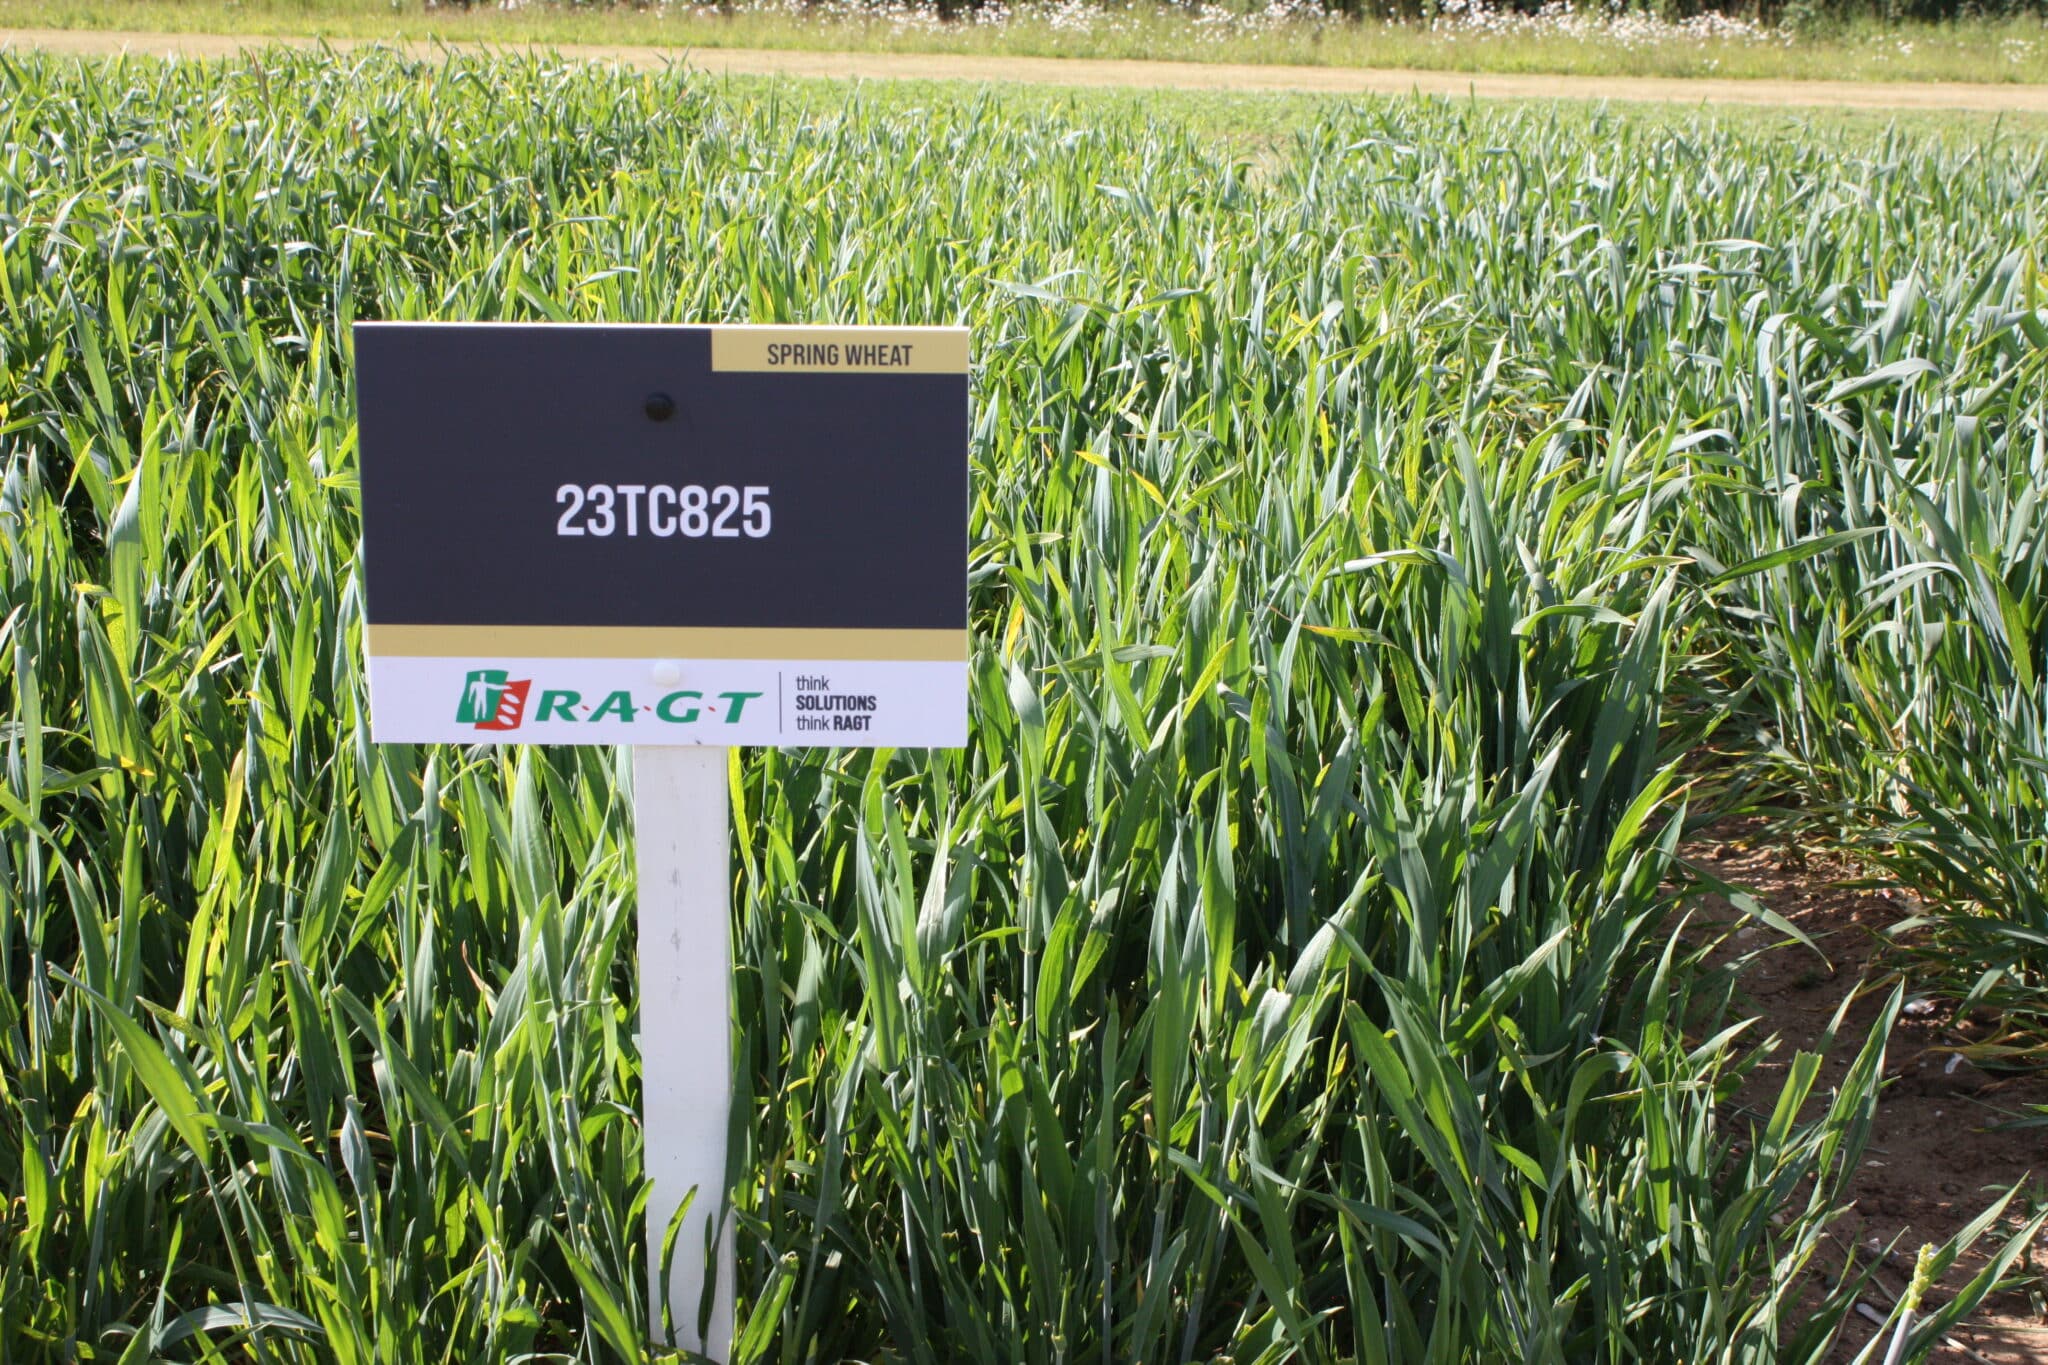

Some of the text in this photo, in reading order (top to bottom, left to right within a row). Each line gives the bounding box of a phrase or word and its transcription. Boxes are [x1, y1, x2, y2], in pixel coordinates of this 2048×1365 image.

[767, 343, 913, 367] SPRING WHEAT
[556, 484, 772, 538] 23TC825
[796, 675, 830, 691] think
[795, 695, 877, 711] SOLUTIONS
[796, 715, 872, 731] think RAGT
